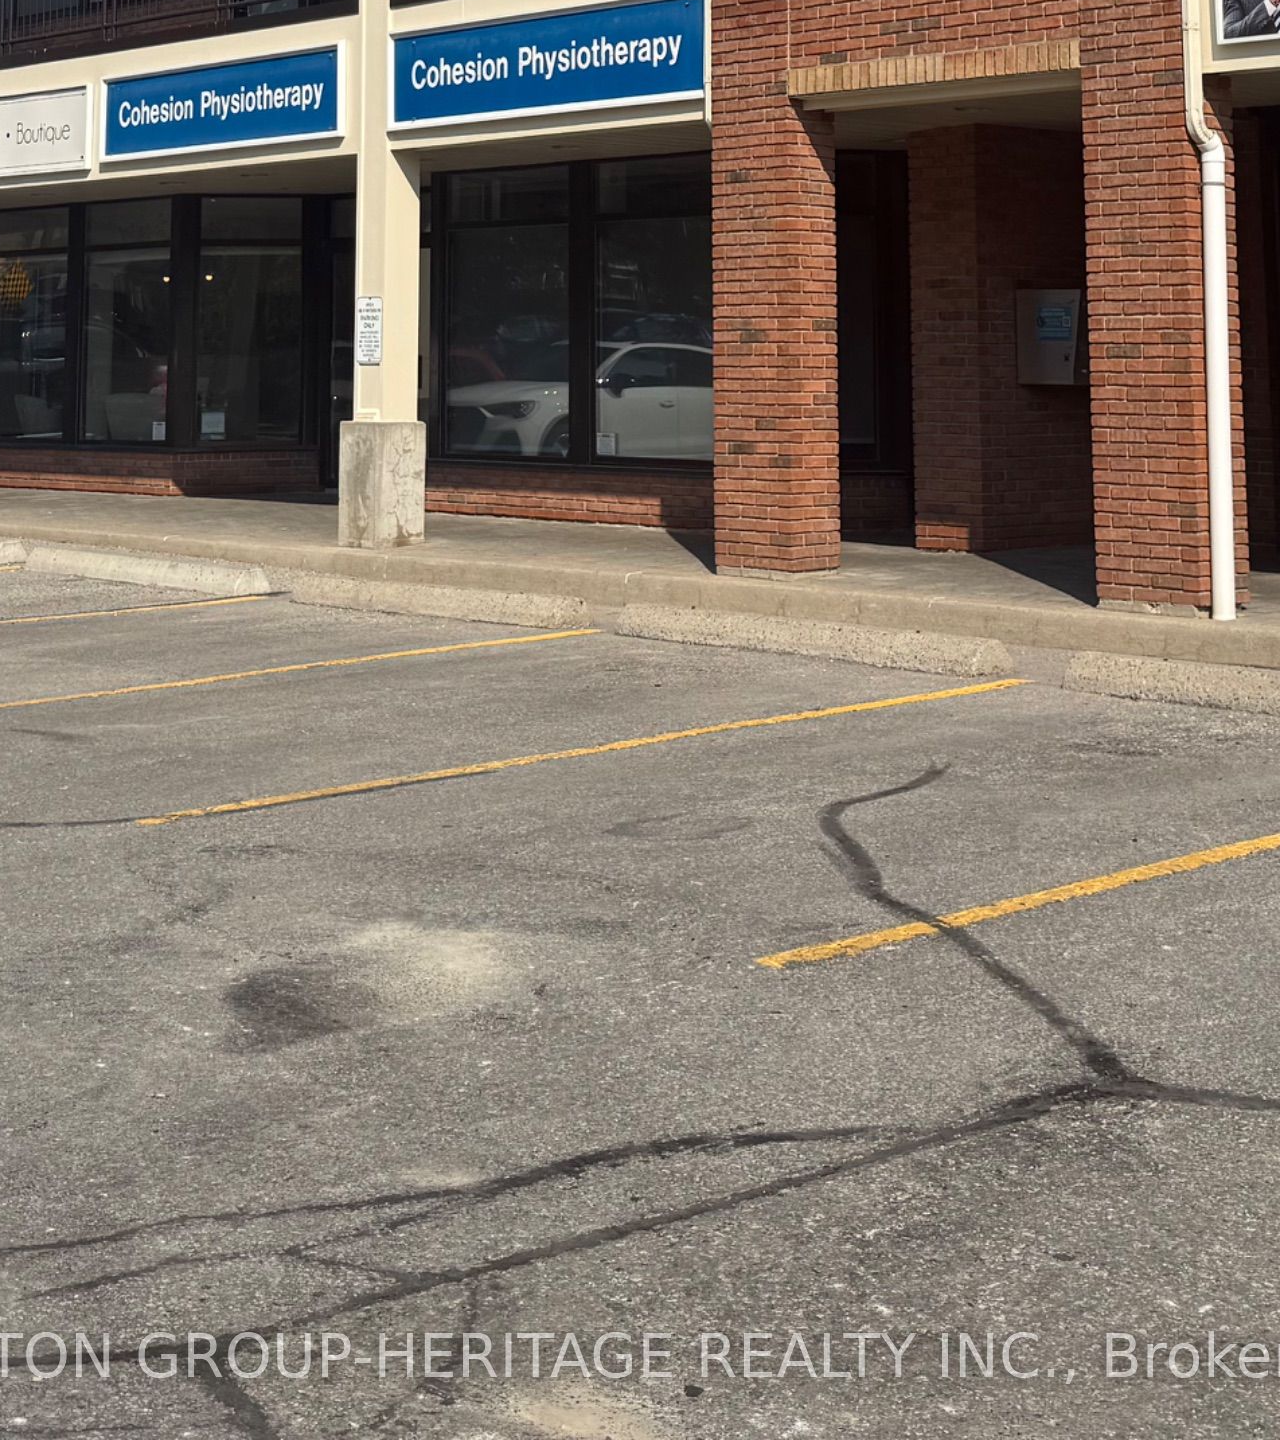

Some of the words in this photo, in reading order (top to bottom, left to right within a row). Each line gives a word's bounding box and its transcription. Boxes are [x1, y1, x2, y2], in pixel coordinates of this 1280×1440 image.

[411, 52, 509, 90] Cohesion
[517, 34, 682, 80] Physiotherapy
[118, 95, 194, 129] Cohesion
[200, 82, 324, 121] Physiotherapy
[16, 121, 70, 145] Boutique
